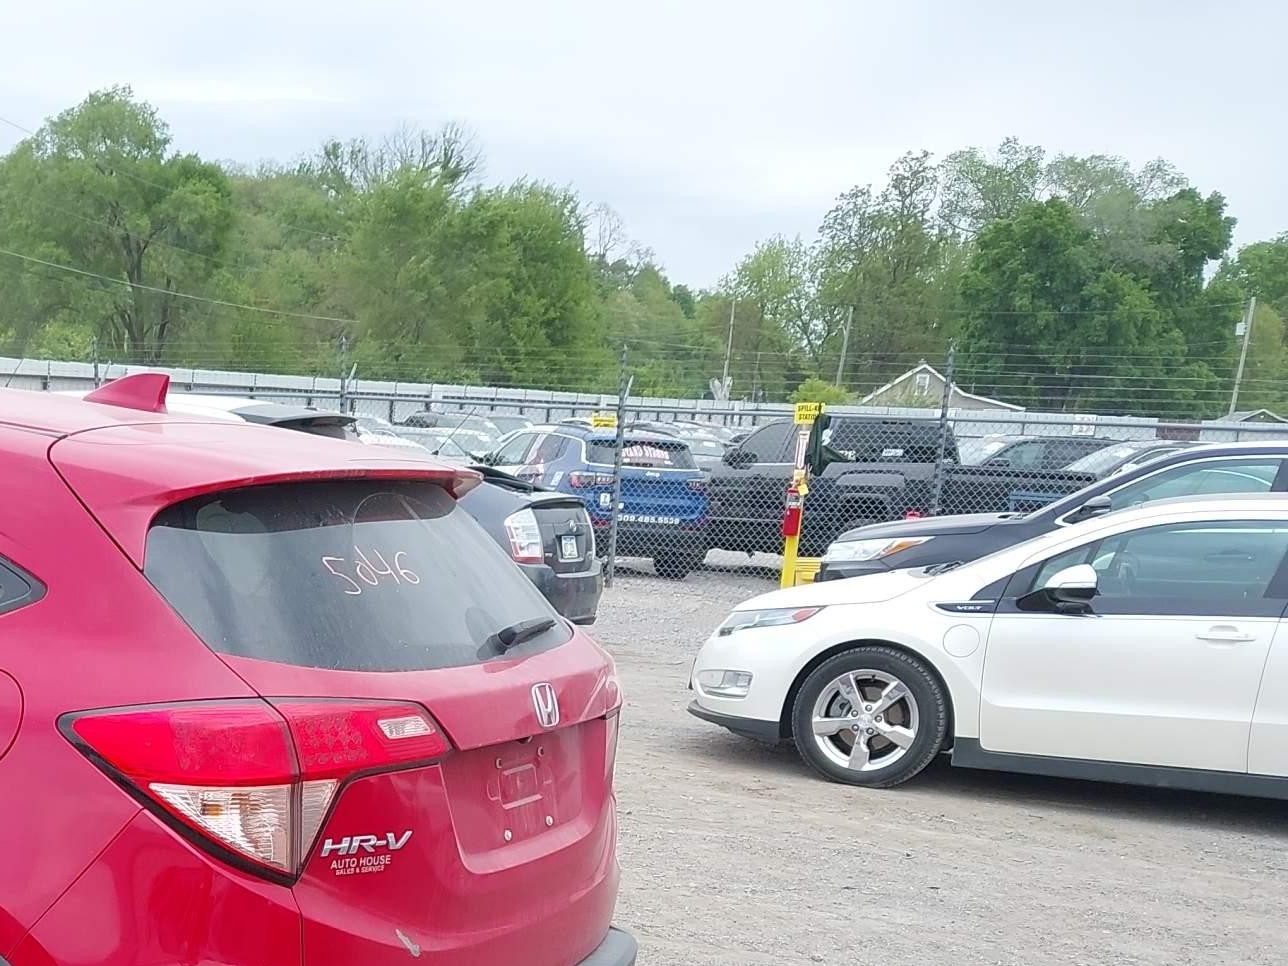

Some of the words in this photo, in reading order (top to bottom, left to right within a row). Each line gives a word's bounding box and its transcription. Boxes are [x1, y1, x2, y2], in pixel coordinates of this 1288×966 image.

[322, 545, 420, 596] 5046
[320, 830, 413, 857] HR-V
[330, 858, 357, 870] AUTO
[359, 854, 392, 867] HOUSE
